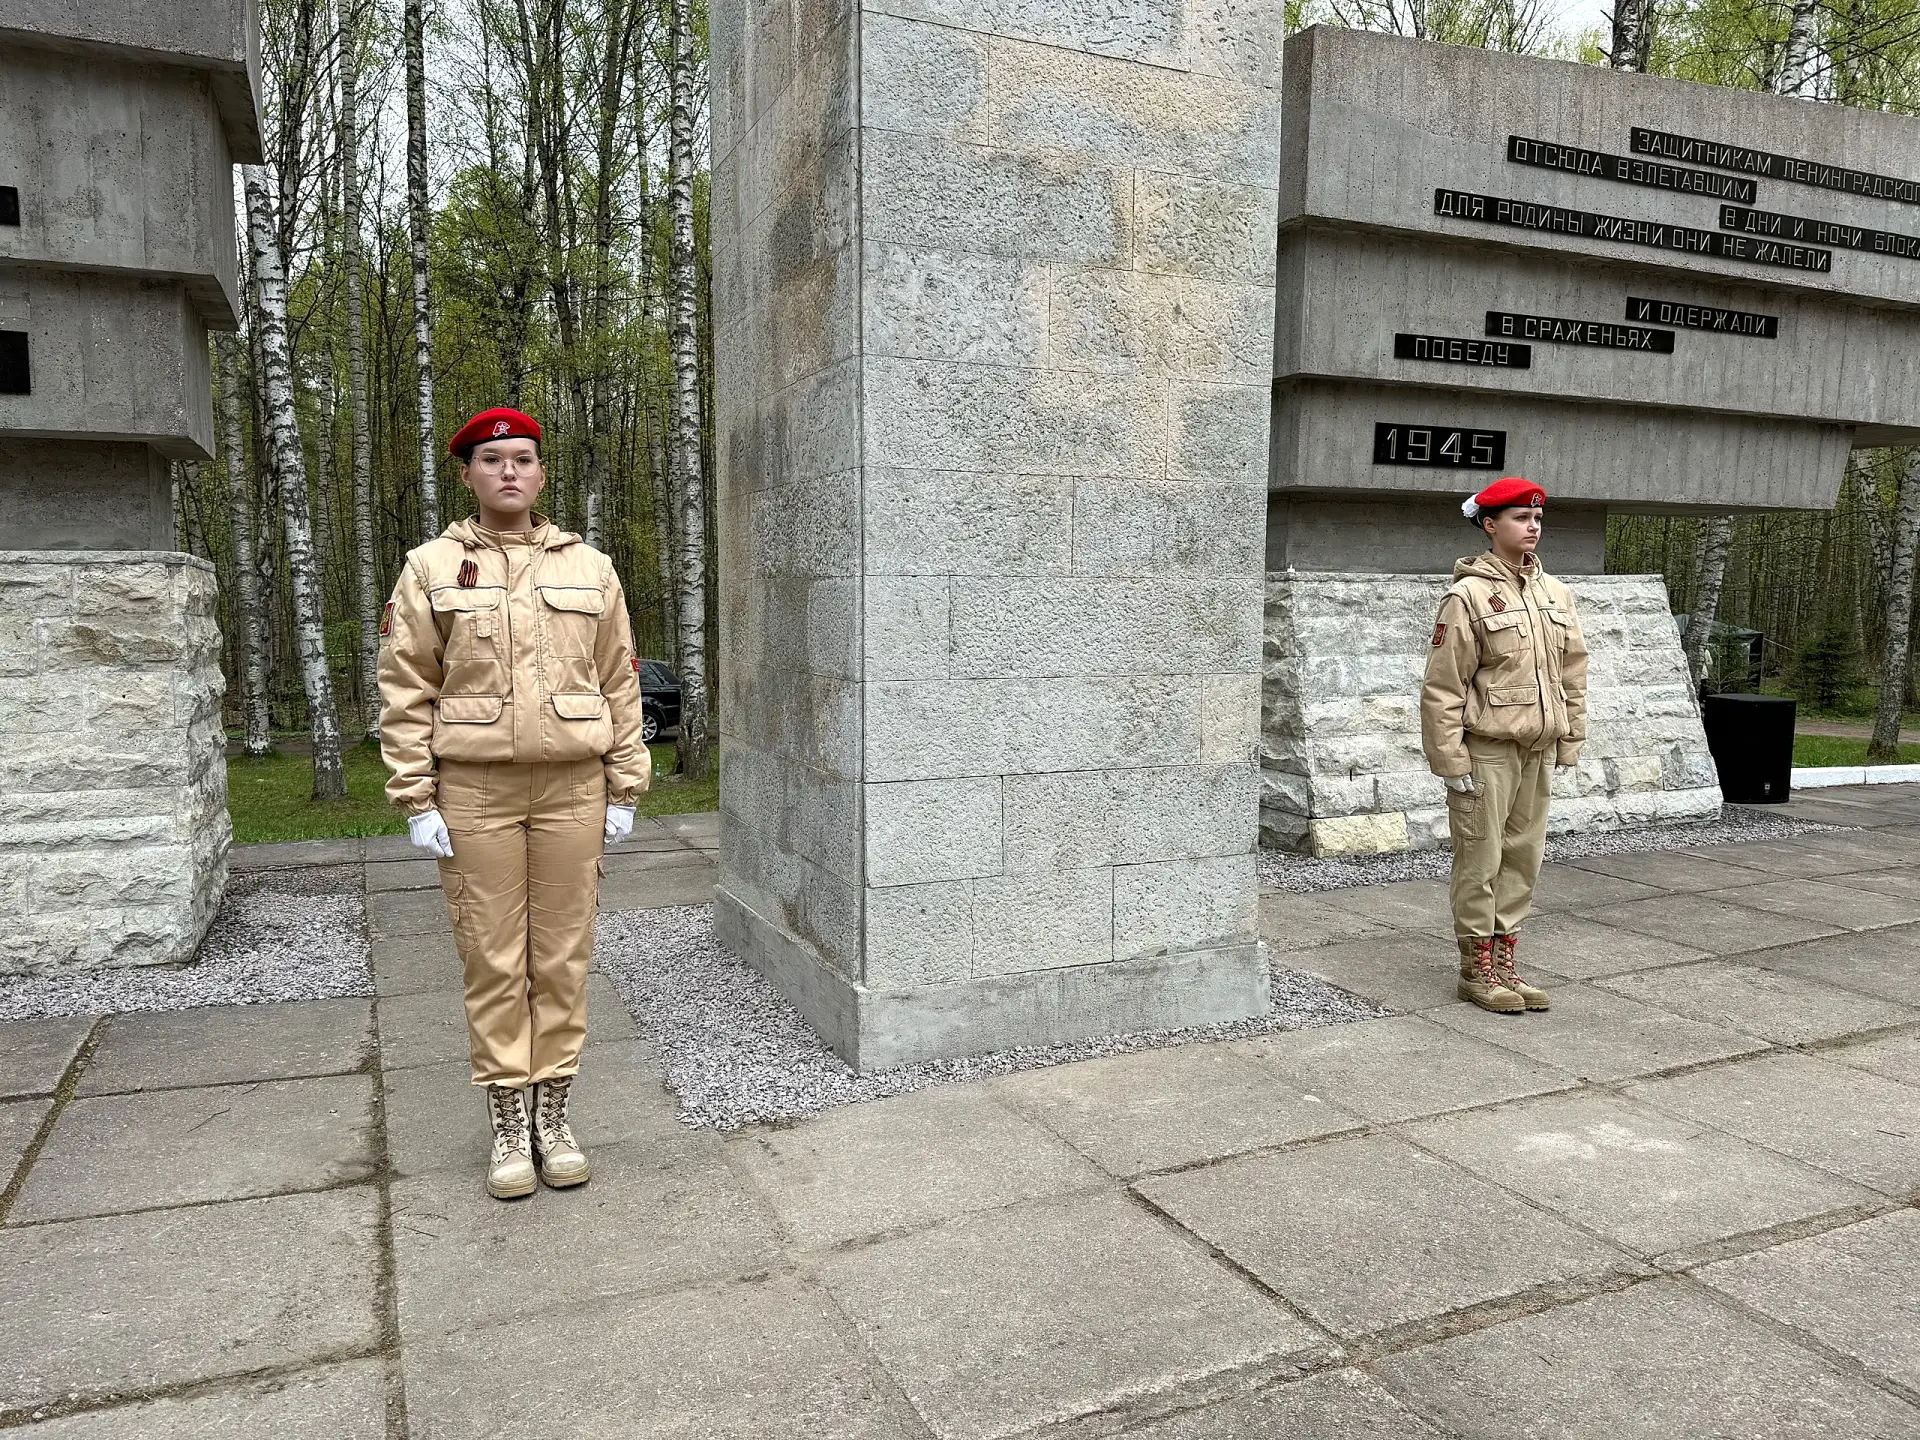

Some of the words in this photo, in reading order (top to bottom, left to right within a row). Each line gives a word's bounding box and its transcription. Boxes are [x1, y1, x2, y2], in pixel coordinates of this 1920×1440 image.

[1515, 140, 1604, 175] ОТСЮДА
[1617, 159, 1749, 200] ВЗЛЕТАВШИМ
[1638, 131, 1771, 174] ЗАЩИТНИКАМ
[1439, 192, 1485, 218] ДЛЯ
[1497, 201, 1584, 234] РОДИНЫ
[1594, 216, 1663, 246] ЖИЗНИ
[1672, 229, 1711, 251] ОНИ
[1723, 236, 1746, 258] НЕ
[1755, 241, 1827, 271] ЖАЛЕЛИ
[1725, 208, 1736, 227] В
[1744, 212, 1781, 235] ДНИ
[1793, 219, 1804, 238] И
[1817, 224, 1862, 247] НОЧИ
[1502, 316, 1514, 335] В
[1525, 318, 1652, 349] СРАЖЕНЬЯХ
[1638, 301, 1650, 320] И
[1660, 304, 1766, 335] ОДЕРЖАЛИ
[1415, 337, 1509, 366] ПОБЕДУ
[1387, 428, 1494, 465] 1945
